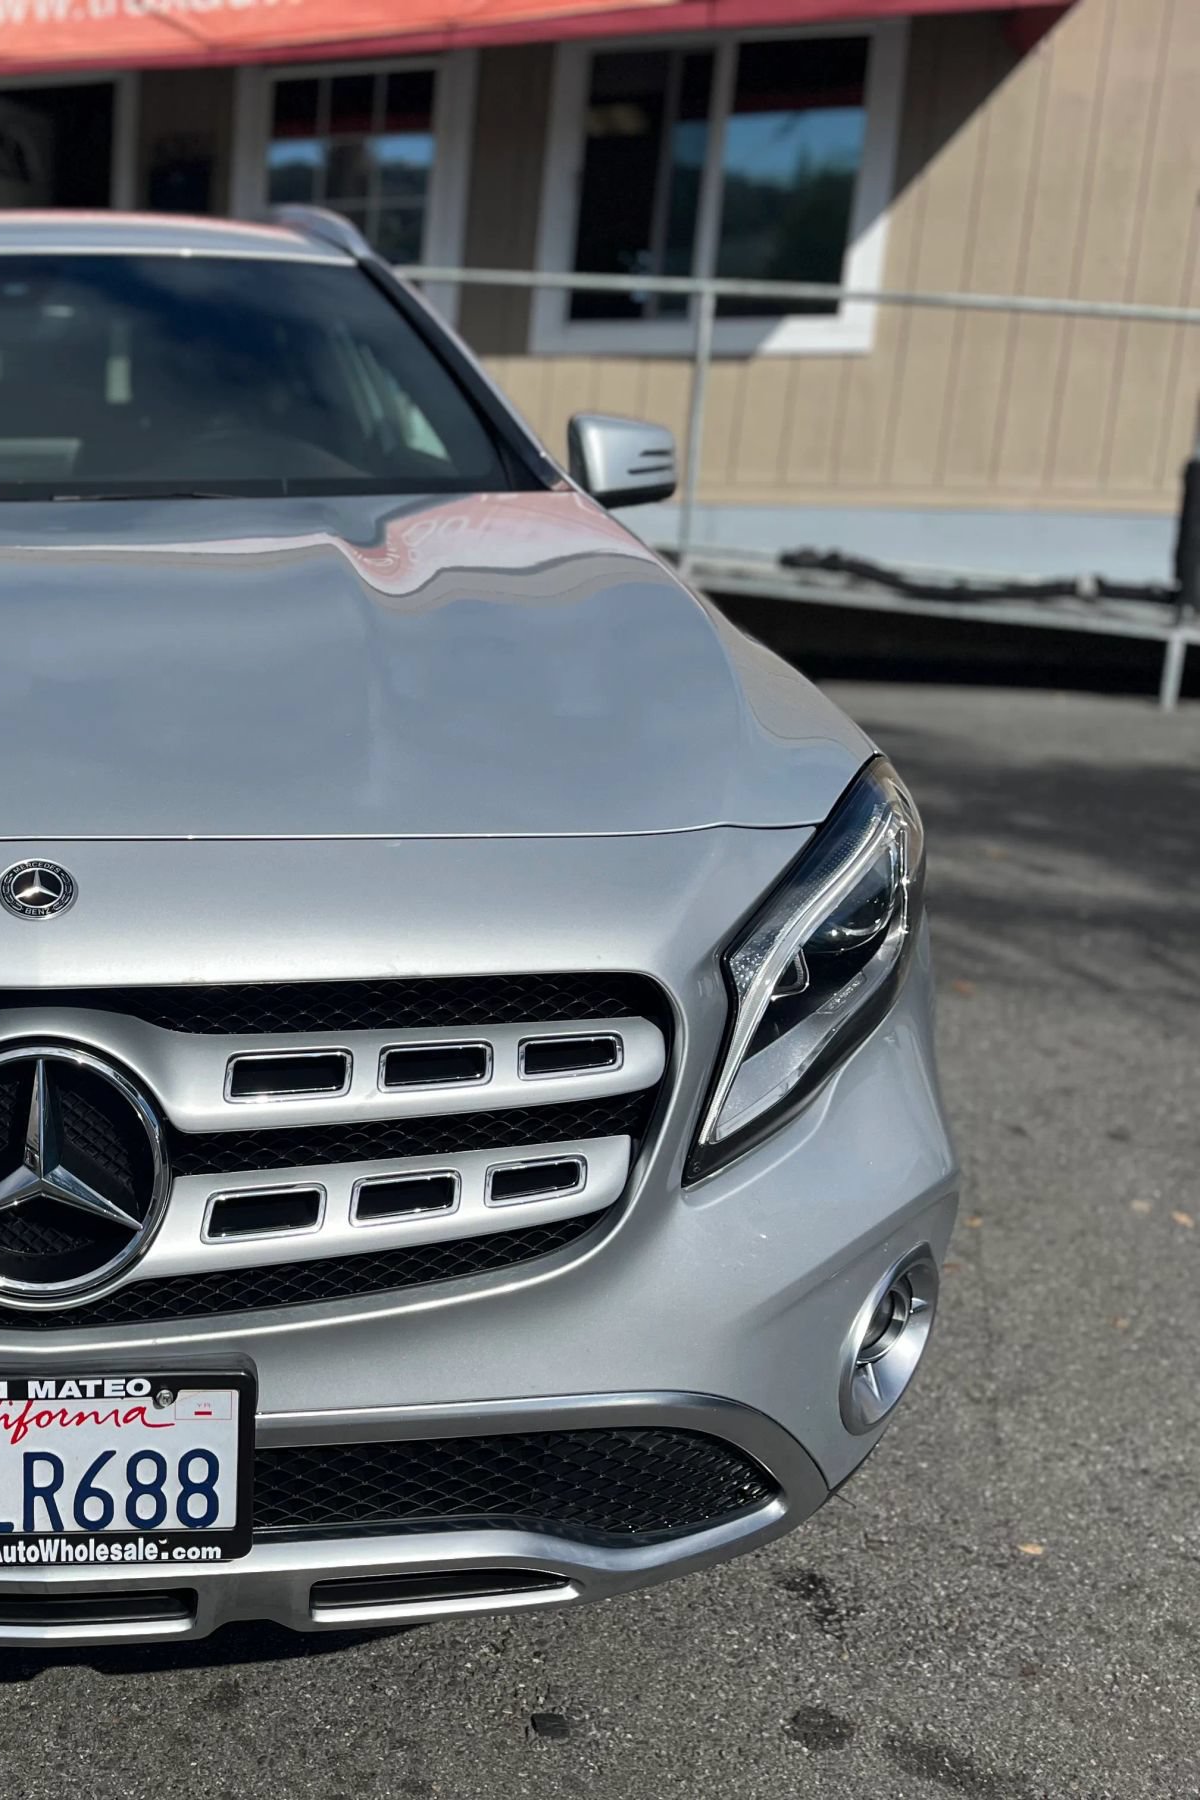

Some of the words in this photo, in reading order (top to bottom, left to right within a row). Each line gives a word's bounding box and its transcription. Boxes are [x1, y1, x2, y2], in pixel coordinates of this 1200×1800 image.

[12, 861, 61, 874] MERCEDES
[24, 906, 52, 916] BENZ
[28, 1378, 152, 1399] MATEO
